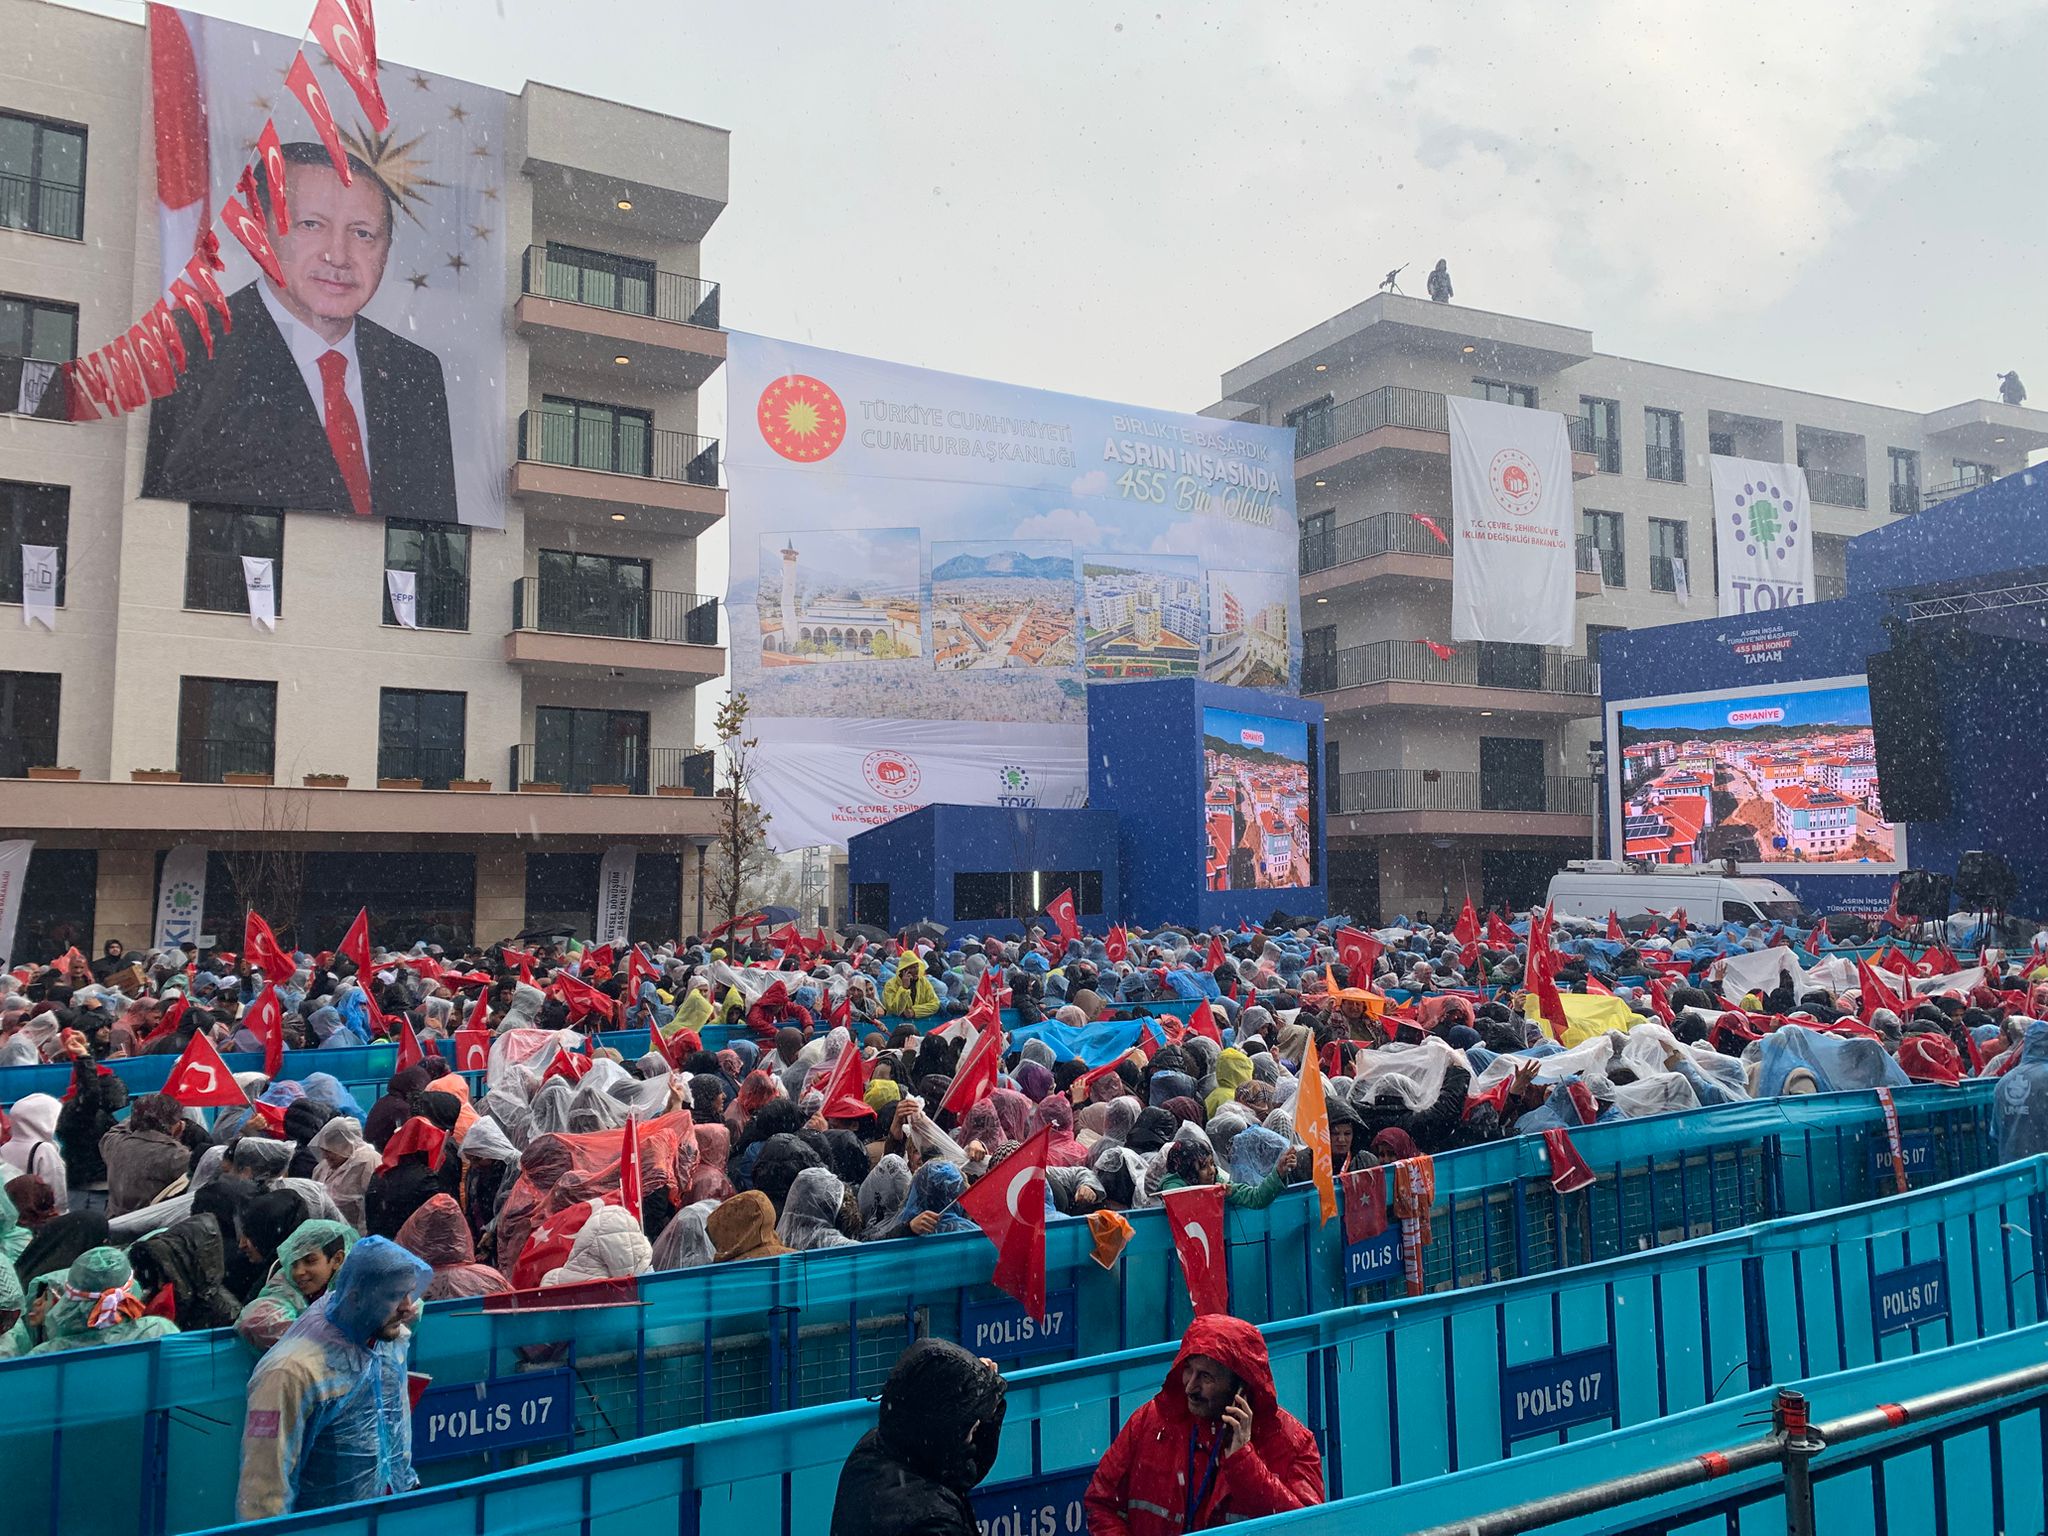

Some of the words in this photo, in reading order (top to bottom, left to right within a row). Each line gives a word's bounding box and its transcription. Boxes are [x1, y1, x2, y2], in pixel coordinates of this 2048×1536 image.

[860, 399, 943, 427] TÜRKİYE
[947, 410, 1073, 443] CUMHURİYETİ
[861, 428, 1077, 468] CUMHURBAŞKANLIĞI
[1112, 414, 1193, 444] BİRLİKTE
[1194, 434, 1269, 463] BAŞARDIK
[1104, 437, 1177, 473] ASRIN
[1116, 468, 1168, 504] 455
[1174, 475, 1212, 512] Bin
[1221, 484, 1273, 526] Olduk
[1471, 520, 1486, 529] T.C.
[1549, 528, 1559, 537] VE
[1741, 629, 1761, 637] ASRIN
[1735, 645, 1751, 653] 455
[1765, 639, 1791, 650] KONUT
[1743, 650, 1782, 665] TAMAM
[1731, 709, 1779, 722] OSMANİYE
[838, 805, 856, 814] T.C.
[857, 804, 891, 816] ÇEVRE,
[1912, 1147, 1926, 1164] 07
[1924, 1280, 1939, 1305] 07
[1041, 1311, 1064, 1336] 07
[1579, 1372, 1602, 1403] 07
[521, 1396, 553, 1425] 07
